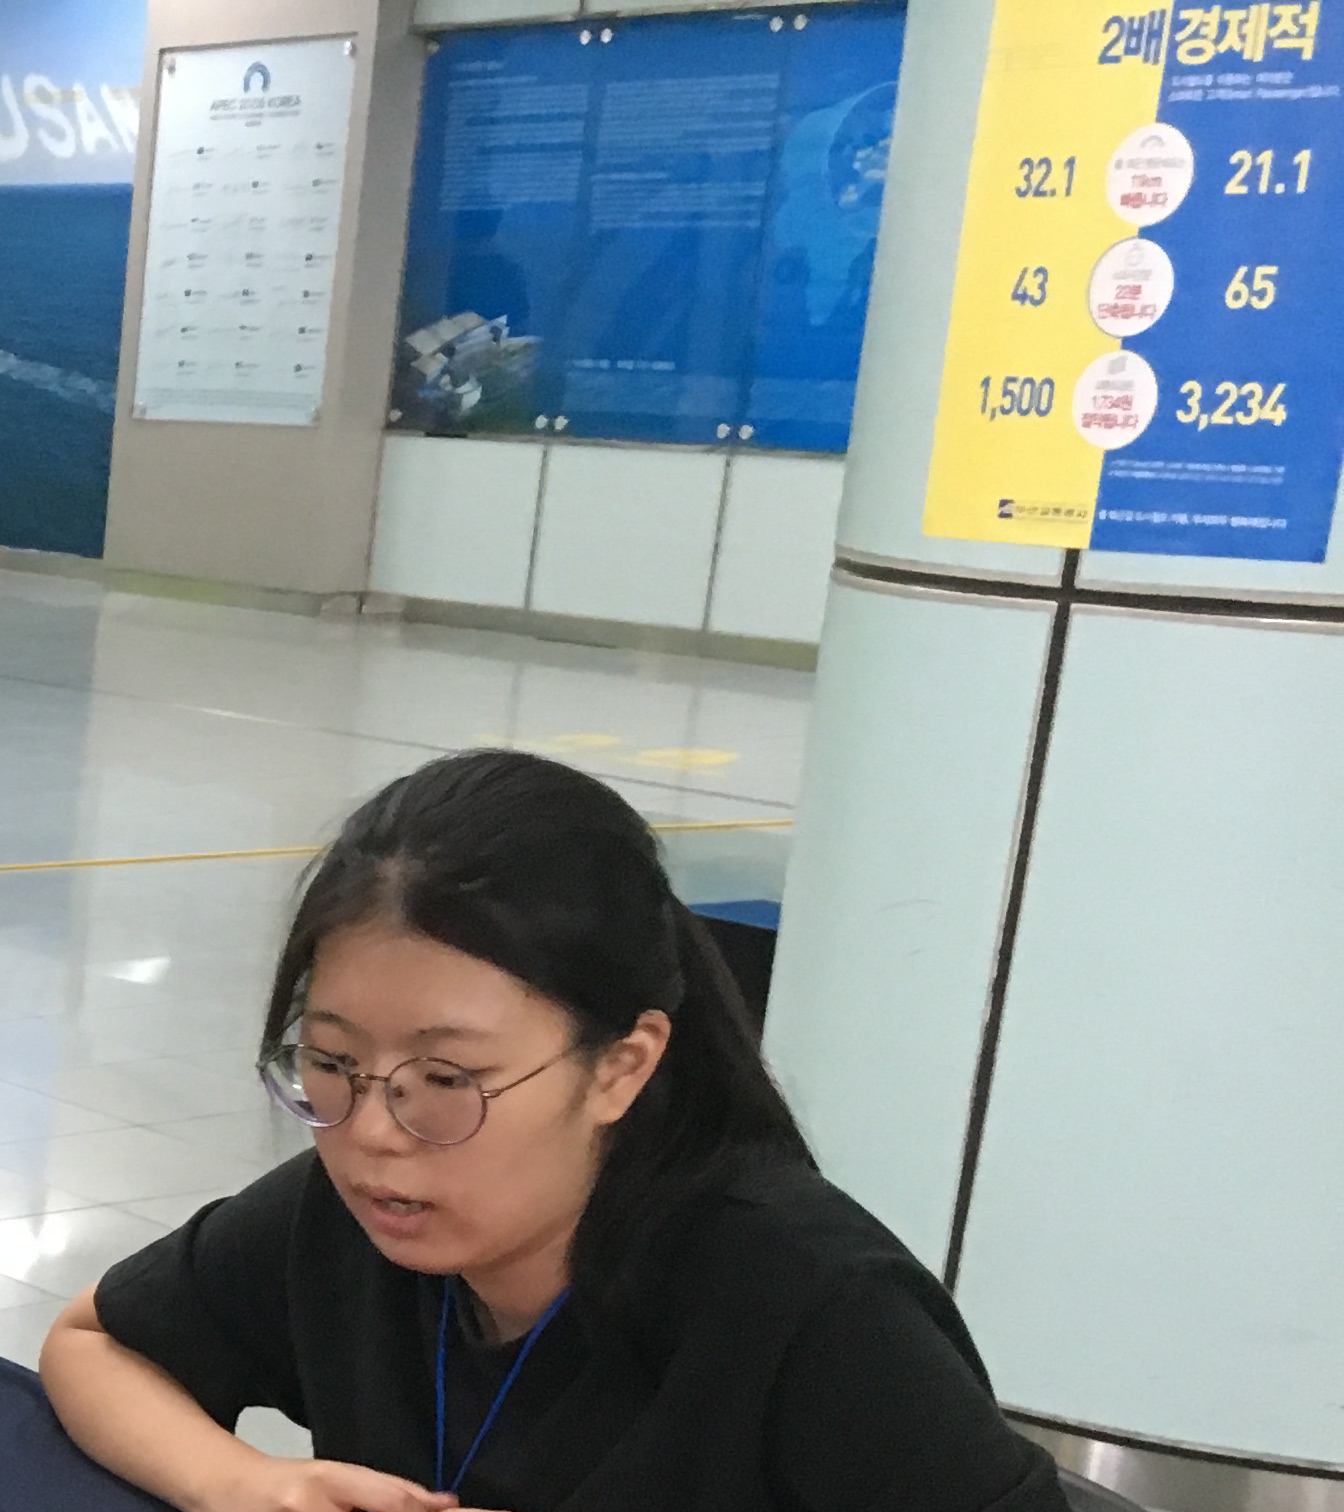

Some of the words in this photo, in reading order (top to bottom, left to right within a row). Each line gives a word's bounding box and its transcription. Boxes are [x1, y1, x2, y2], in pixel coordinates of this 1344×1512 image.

[1098, 8, 1166, 64] 2배
[1175, 0, 1321, 64] 경제적
[1015, 156, 1076, 197] 32.1
[1224, 150, 1312, 194] 21.1
[1011, 266, 1049, 307] 43
[1224, 265, 1279, 309] 65
[979, 375, 1056, 422] 1,500
[1175, 380, 1287, 431] 3,234
